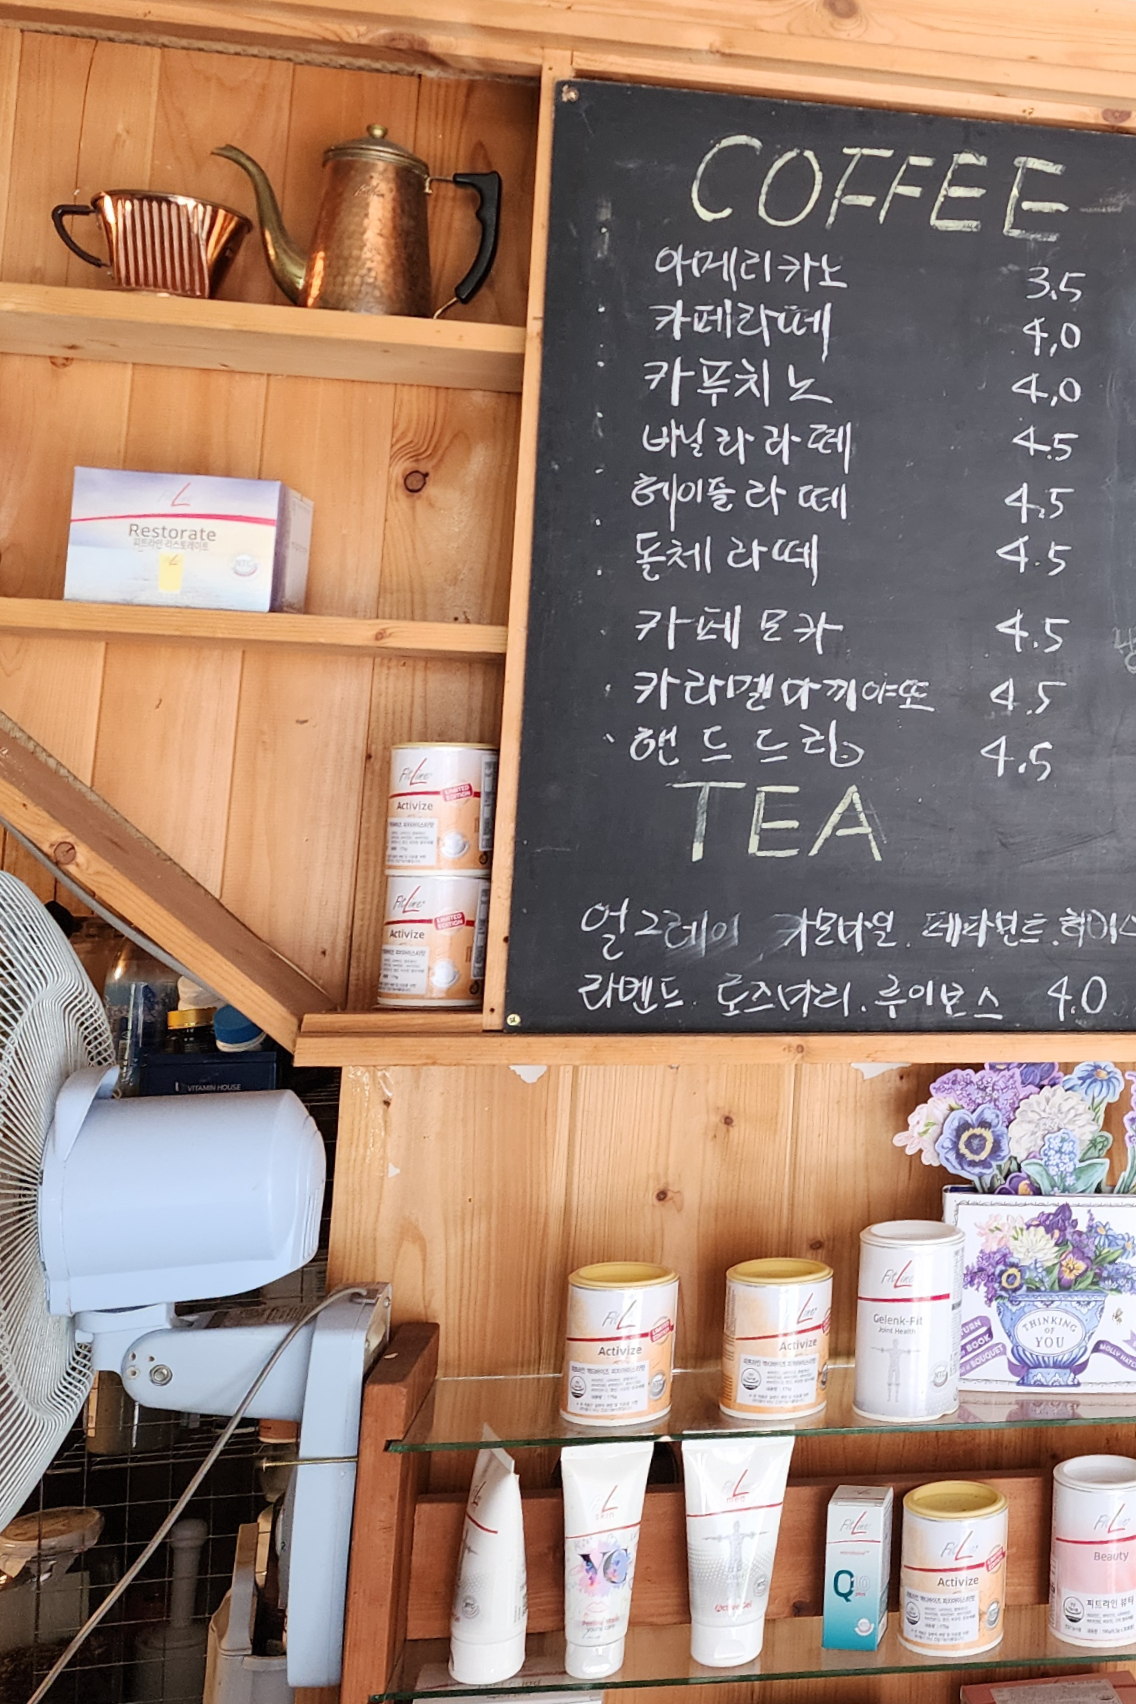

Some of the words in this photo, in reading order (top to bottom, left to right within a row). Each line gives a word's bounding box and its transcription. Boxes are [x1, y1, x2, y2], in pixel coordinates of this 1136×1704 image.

[692, 134, 1068, 241] COFFEE
[656, 244, 848, 291] 아메리카노
[648, 299, 832, 361] 카페라떼
[129, 523, 217, 542] Restorate
[397, 802, 433, 811] Activize
[670, 781, 882, 862] TEA
[389, 929, 424, 940] Activize
[217, 1083, 241, 1091] HOUSE
[873, 1313, 923, 1326] Gelenk-Fit
[1022, 1316, 1077, 1333] THINKING
[894, 1327, 916, 1335] Health
[780, 1339, 817, 1351] Activize
[966, 1333, 991, 1352] BOOK
[1035, 1337, 1065, 1349] YOU
[598, 1345, 642, 1356] Activize
[970, 1344, 1004, 1367] BOUQUET
[1099, 1343, 1120, 1359] MOLLY
[1094, 1551, 1129, 1563] Beauty
[937, 1577, 979, 1588] Activize
